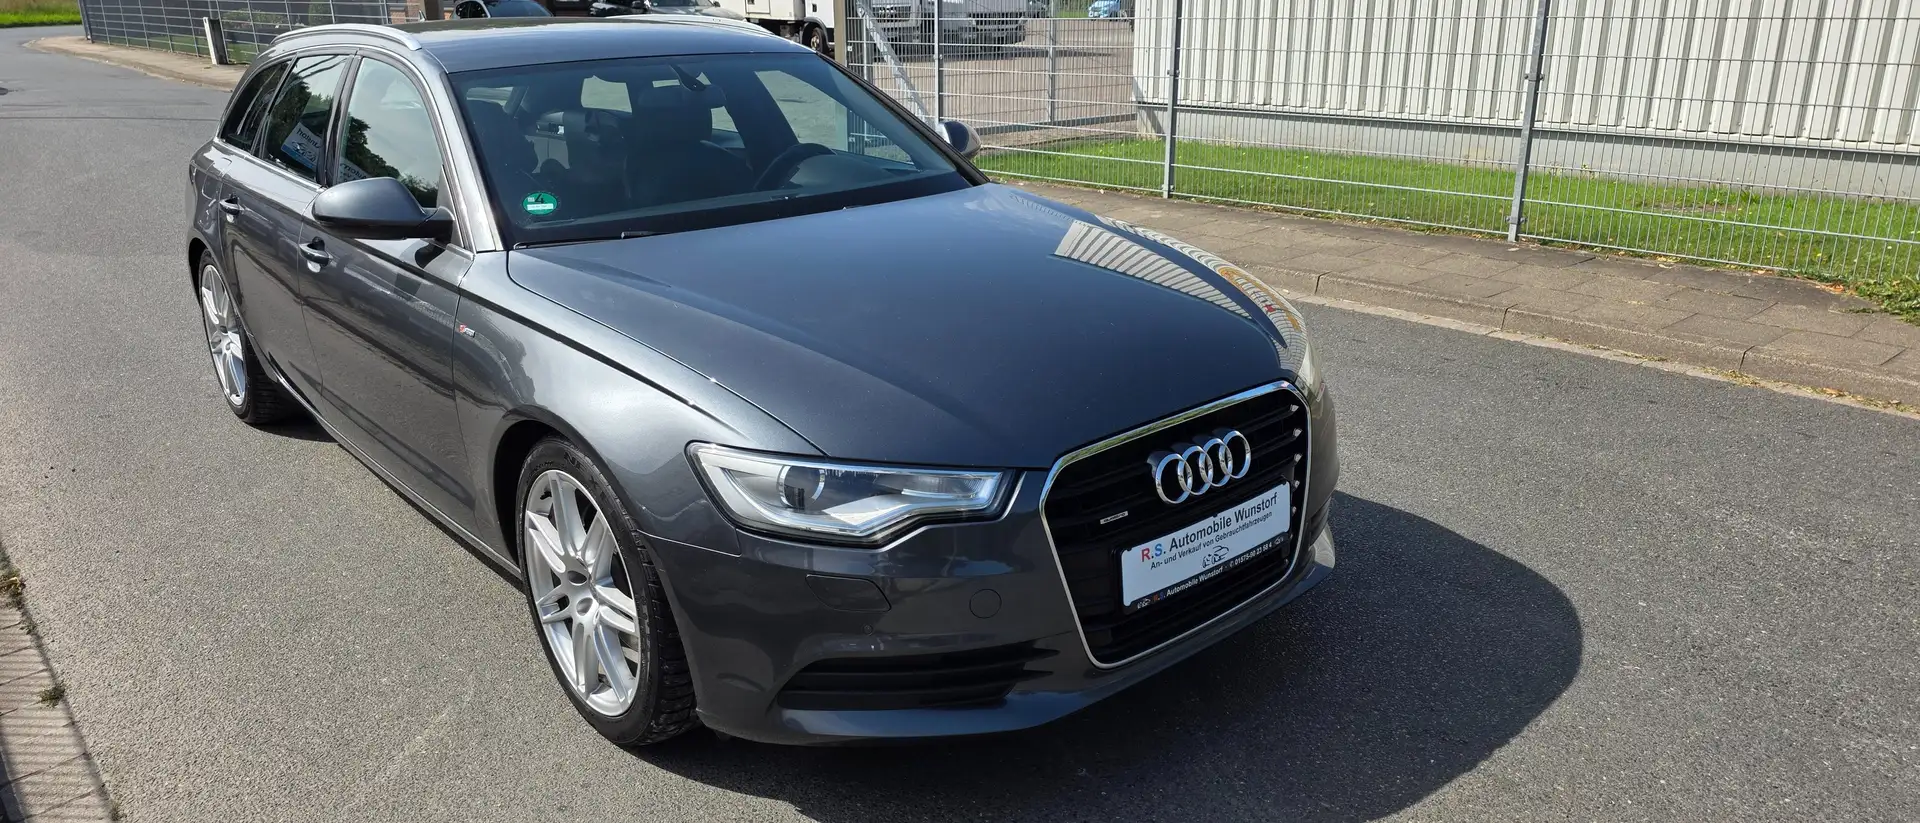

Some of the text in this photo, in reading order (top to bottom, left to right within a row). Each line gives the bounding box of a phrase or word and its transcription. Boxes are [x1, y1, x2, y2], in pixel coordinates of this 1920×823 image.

[535, 193, 544, 204] 4
[1141, 492, 1278, 562] R.S. Automobile Wunstorf
[1150, 560, 1163, 570] An-
[1164, 552, 1177, 566] und
[1178, 542, 1202, 559] Verkauf
[1203, 537, 1214, 548] von
[1166, 577, 1199, 597] Automobile
[1199, 566, 1223, 583] Wunstorf
